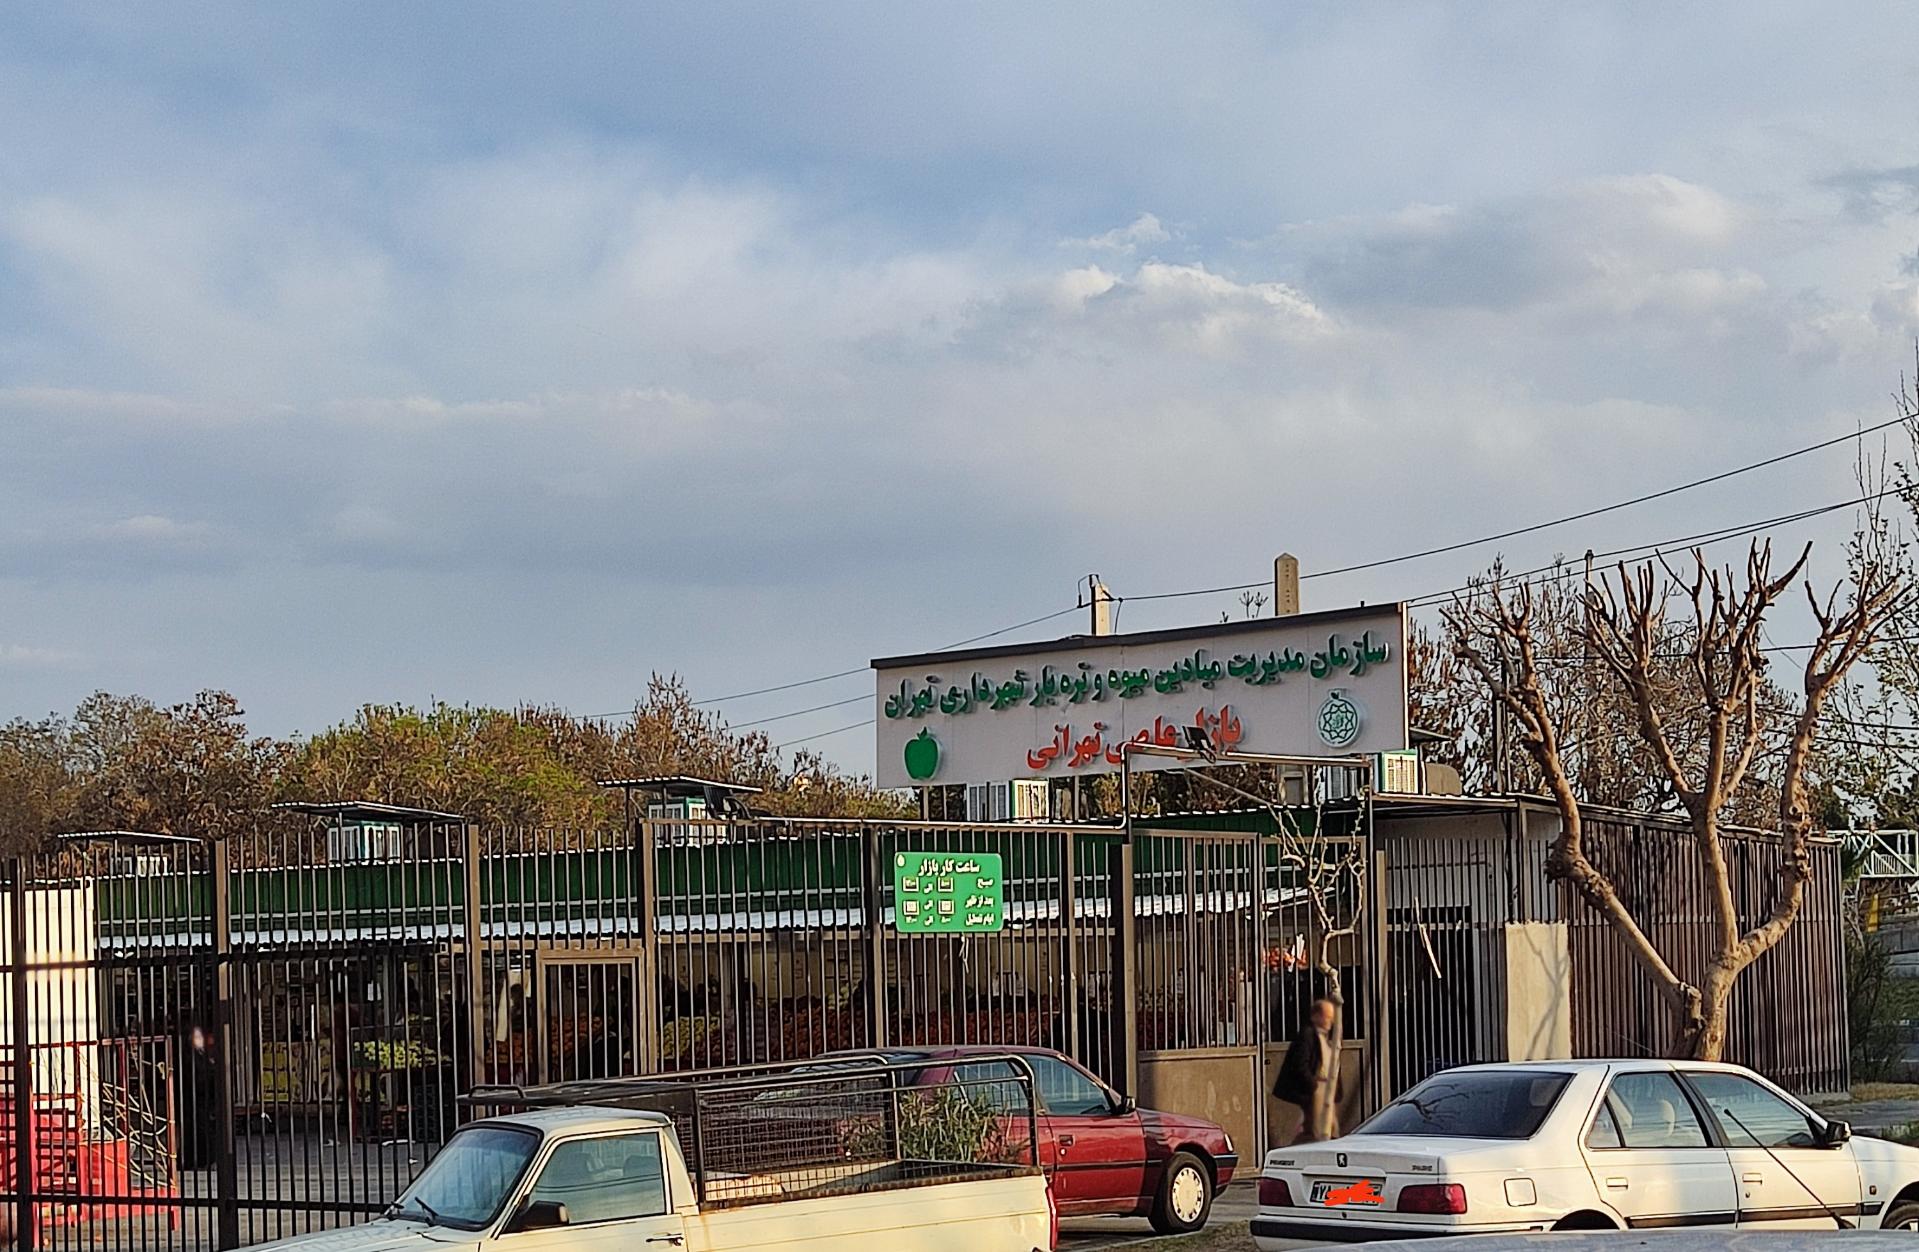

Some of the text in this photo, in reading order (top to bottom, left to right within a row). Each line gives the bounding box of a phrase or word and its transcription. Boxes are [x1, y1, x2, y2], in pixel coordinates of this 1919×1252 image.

[1154, 649, 1221, 693] میادین
[1228, 648, 1304, 685] مدیریت
[1310, 630, 1389, 679] سازمان
[885, 675, 940, 718] تهران
[940, 669, 1028, 713] شهرداری
[1092, 673, 1103, 701] و
[1108, 668, 1149, 698] میوه
[1027, 720, 1104, 769] تهرانی
[918, 858, 980, 877] ساعت کار بازار
